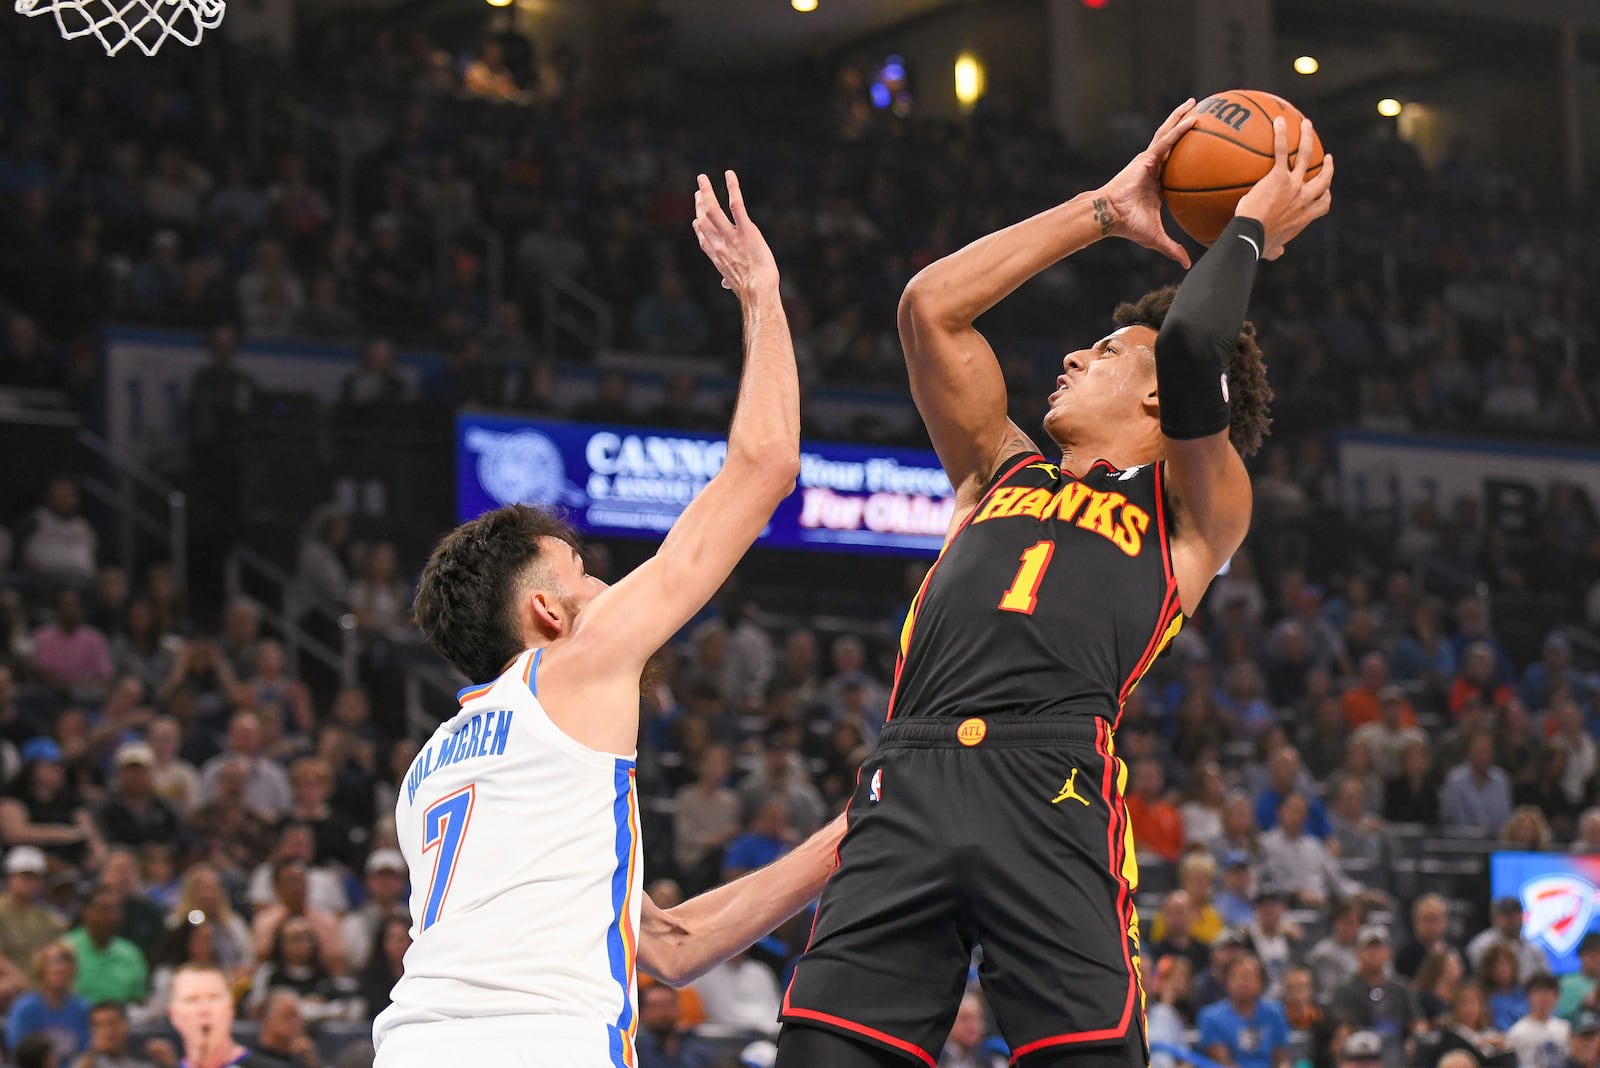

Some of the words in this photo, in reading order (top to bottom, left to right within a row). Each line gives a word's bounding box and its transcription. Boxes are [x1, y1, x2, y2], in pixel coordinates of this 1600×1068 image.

[799, 487, 864, 530] For
[998, 540, 1055, 615] 1
[407, 710, 514, 808] HOLMGREN
[961, 725, 982, 737] ATL
[420, 783, 475, 934] 7
